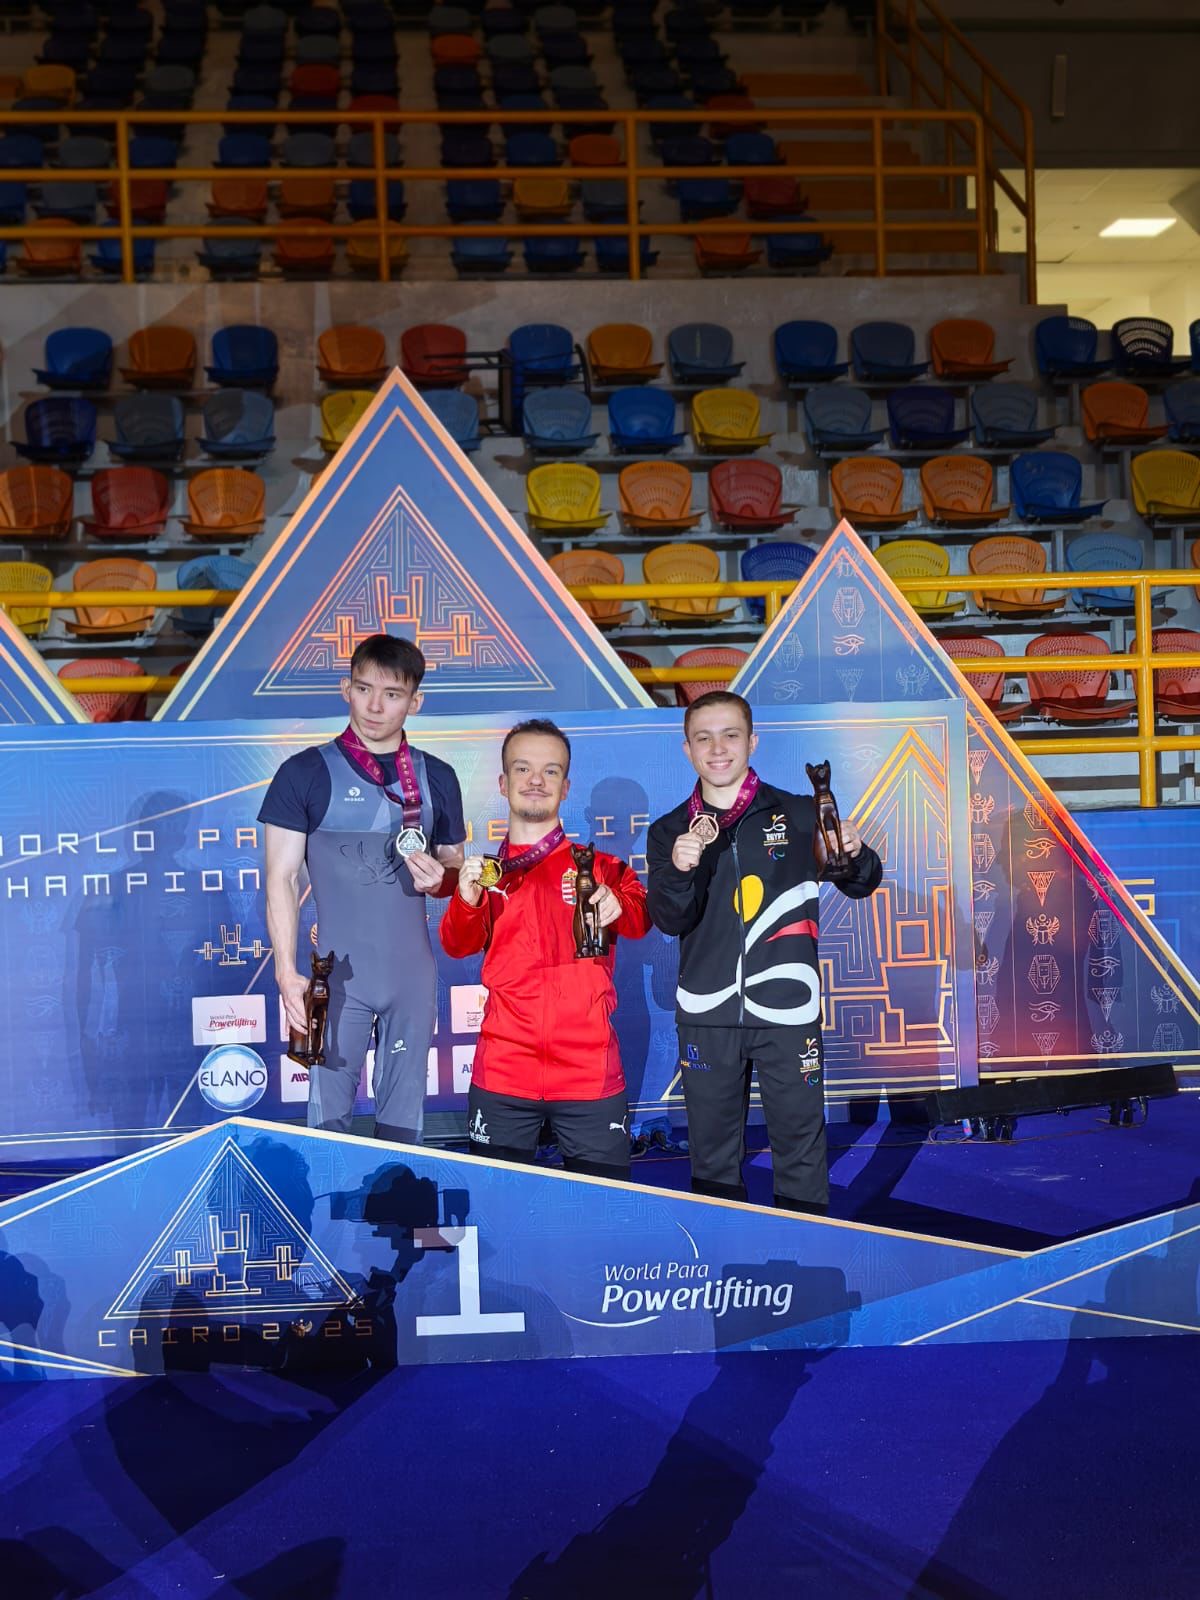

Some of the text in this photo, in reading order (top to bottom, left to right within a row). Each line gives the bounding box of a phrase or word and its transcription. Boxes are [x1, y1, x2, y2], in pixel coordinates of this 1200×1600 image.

[0, 828, 258, 856] ORLD PA
[7, 868, 260, 898] HAMPION
[209, 1018, 257, 1029] Powerlifting
[200, 1070, 266, 1087] ELANO
[413, 1226, 526, 1336] 1
[604, 1262, 709, 1281] World Para
[601, 1276, 793, 1317] Powerlifting
[98, 1324, 241, 1347] CAIRO
